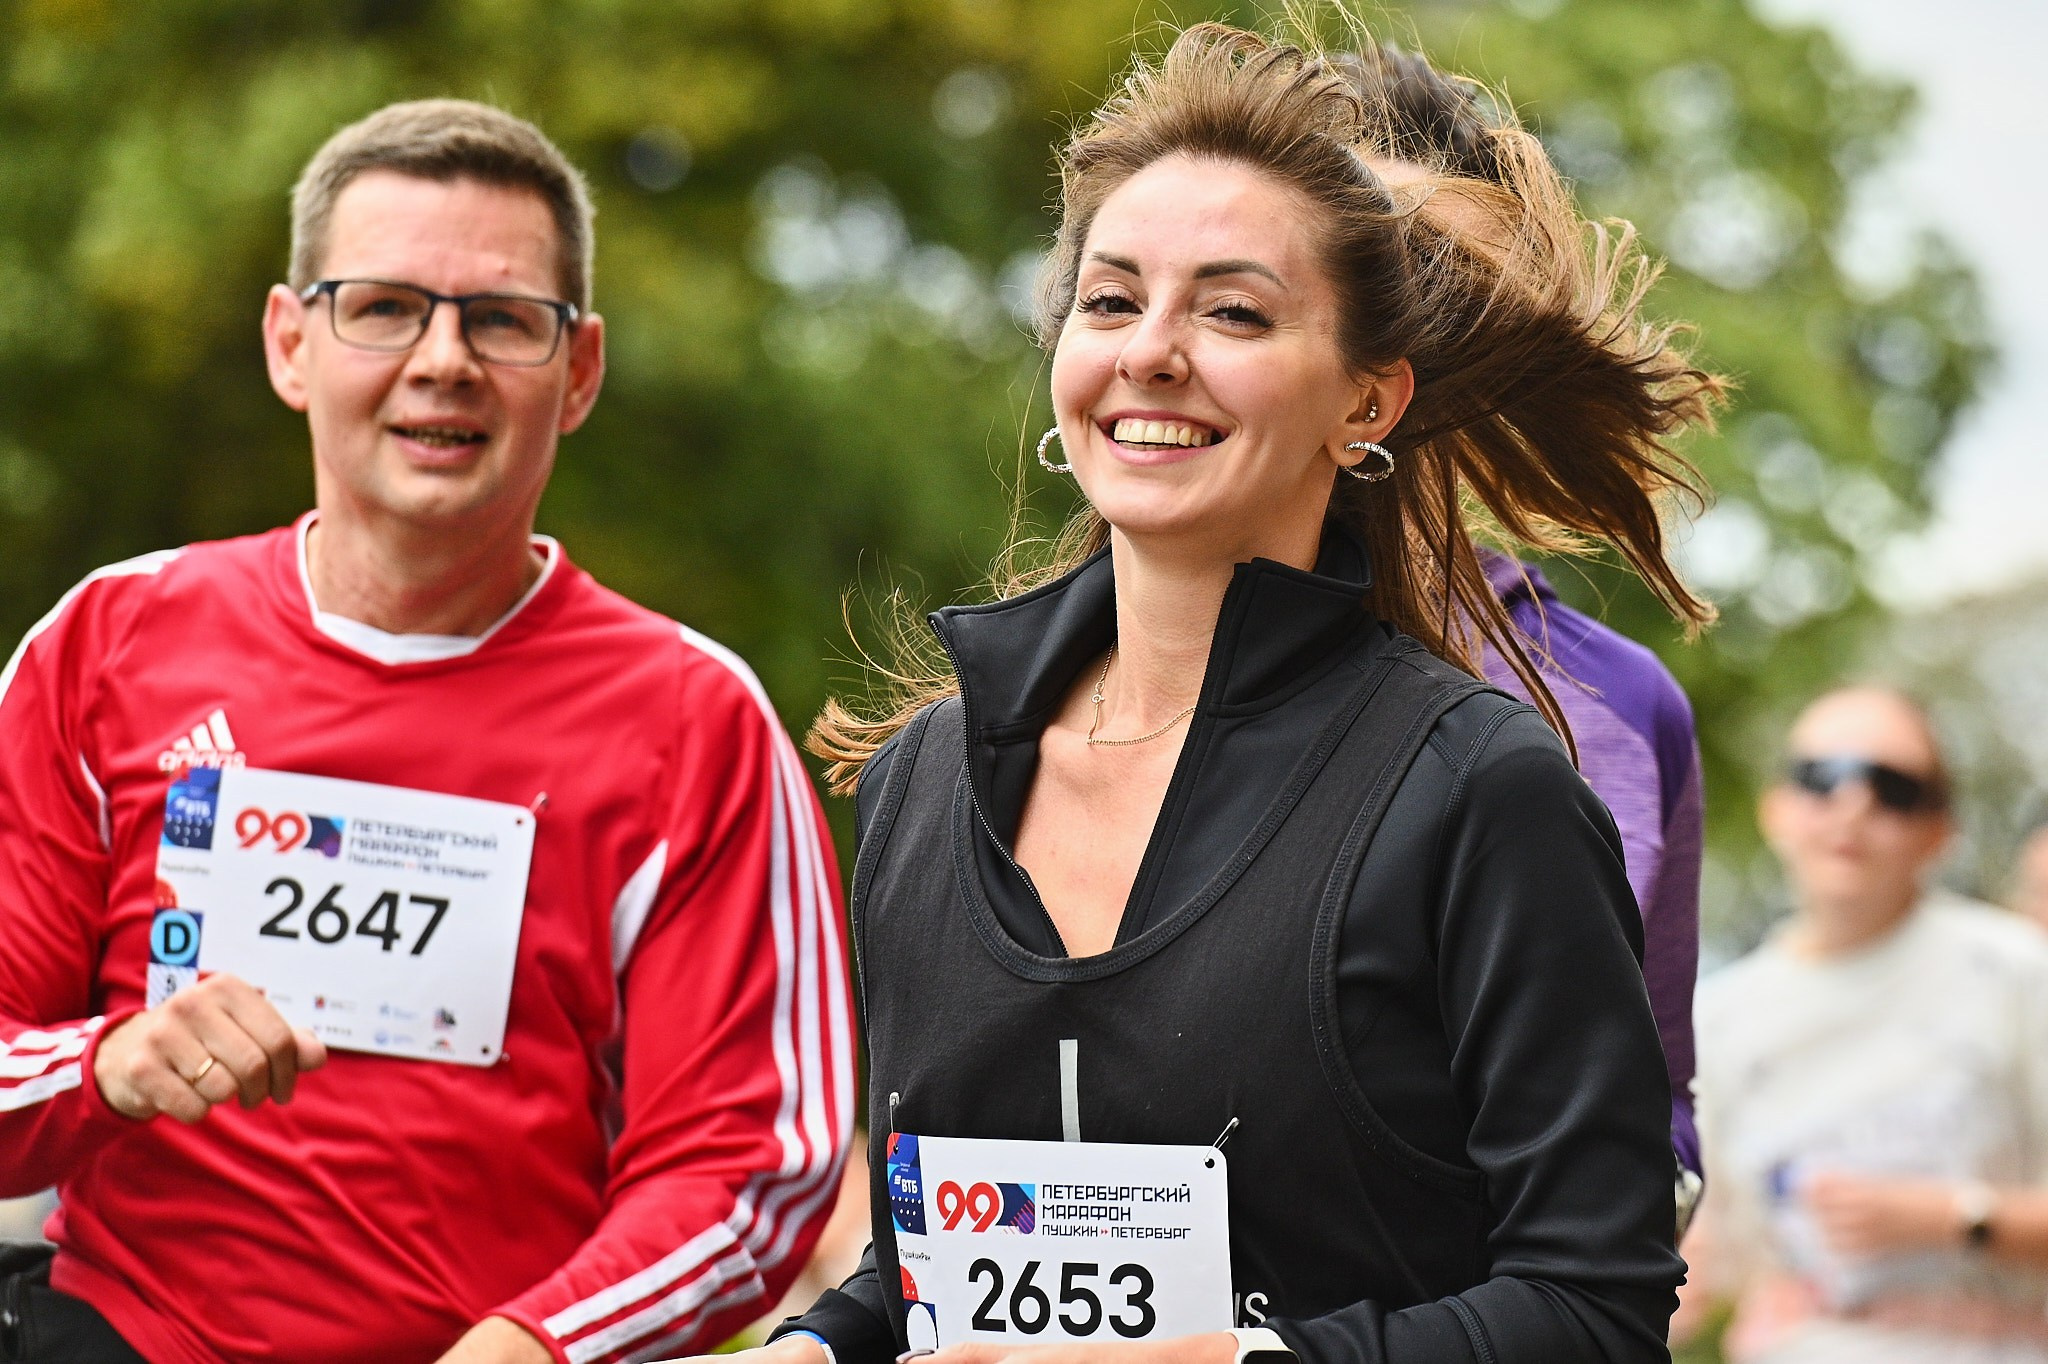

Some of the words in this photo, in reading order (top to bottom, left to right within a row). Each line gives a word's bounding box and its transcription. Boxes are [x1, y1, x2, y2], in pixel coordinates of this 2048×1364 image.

[235, 808, 307, 853] 99
[259, 877, 450, 956] 2647
[164, 922, 191, 955] D
[901, 1178, 918, 1194] ВТБ
[1042, 1183, 1191, 1203] ПЕТЕРБУРГСКИЙ
[936, 1180, 1000, 1232] 99
[1042, 1204, 1131, 1222] МАРАФОН
[1042, 1224, 1099, 1238] ПУШКИН
[1111, 1226, 1191, 1239] ПЕТЕРБУРГ
[968, 1257, 1156, 1339] 2653
